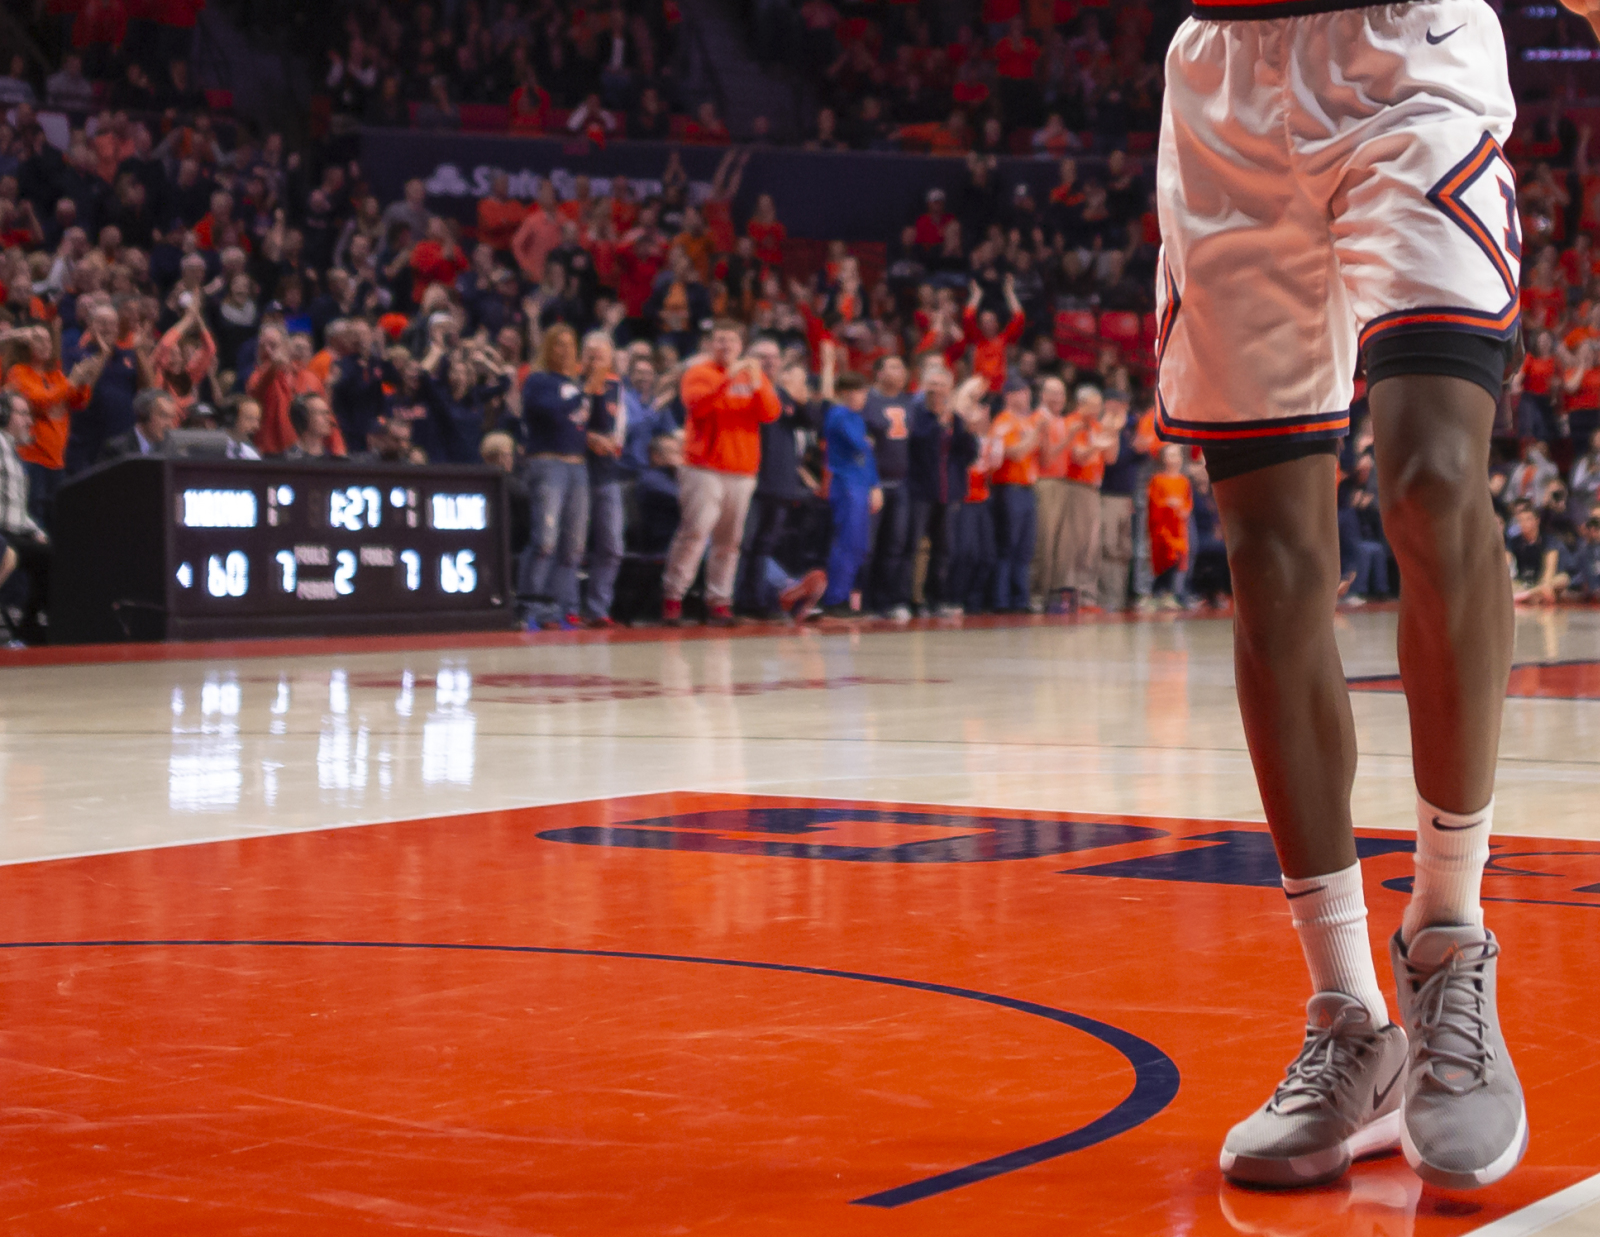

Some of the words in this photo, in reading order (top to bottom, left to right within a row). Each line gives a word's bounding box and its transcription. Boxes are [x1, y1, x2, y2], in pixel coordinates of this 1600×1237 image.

[207, 550, 249, 597] 60
[334, 549, 357, 595] 2
[440, 549, 477, 593] 65
